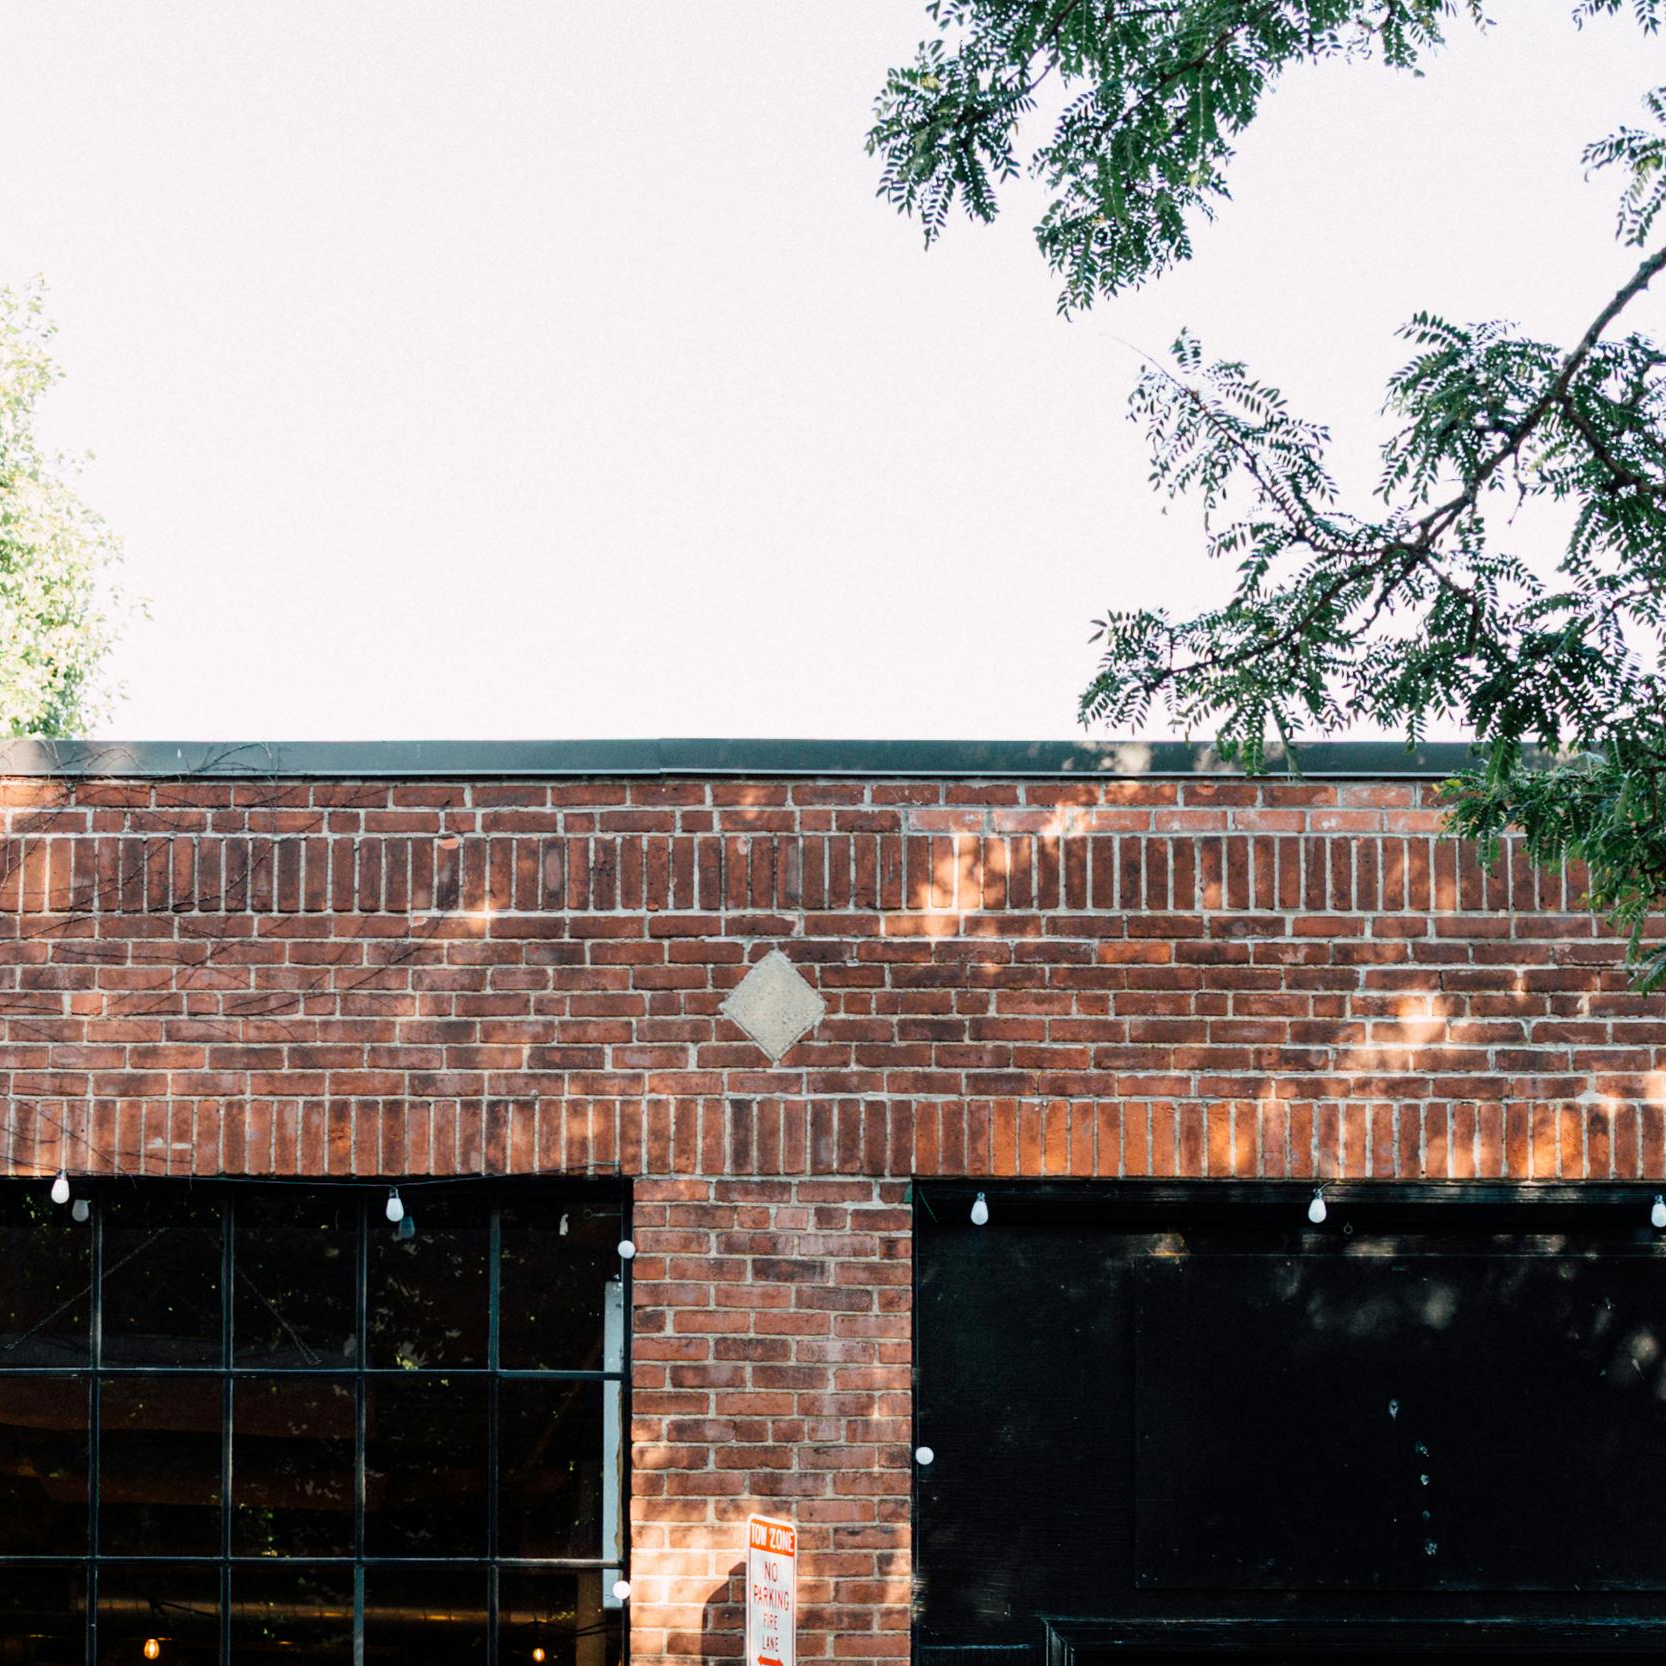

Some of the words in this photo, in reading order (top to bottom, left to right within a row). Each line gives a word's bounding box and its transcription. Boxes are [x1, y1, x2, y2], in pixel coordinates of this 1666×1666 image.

[750, 1522, 767, 1547] TOW
[769, 1527, 794, 1553] ZONE
[764, 1561, 778, 1583] NO
[753, 1584, 789, 1612] PARKING
[763, 1613, 778, 1630] FIRE
[762, 1636, 779, 1653] LANE
